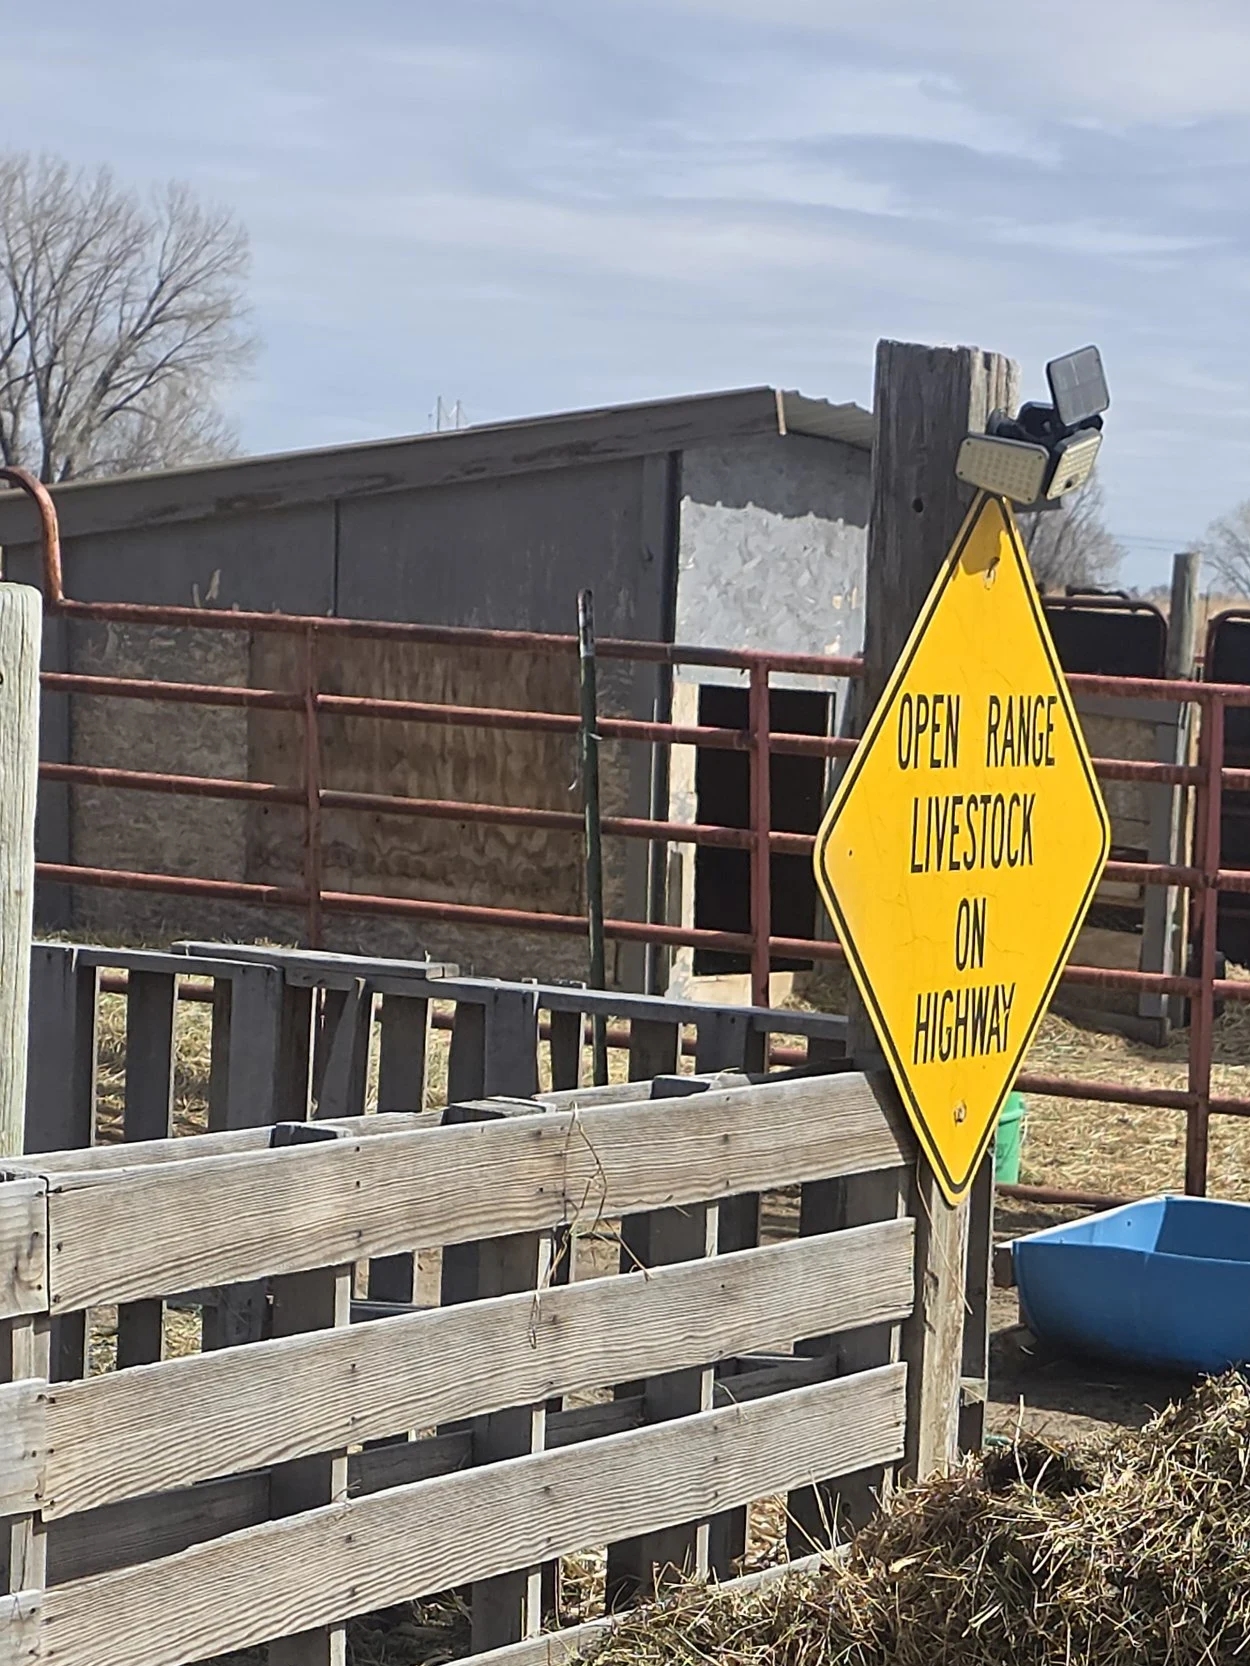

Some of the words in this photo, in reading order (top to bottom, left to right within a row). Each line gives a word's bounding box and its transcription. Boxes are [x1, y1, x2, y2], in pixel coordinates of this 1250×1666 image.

[896, 692, 961, 771] OPEN
[985, 693, 1059, 769] RANGE
[909, 792, 1037, 875] LIVESTOCK
[954, 896, 988, 973] ON
[912, 981, 1017, 1066] HIGHWAY
